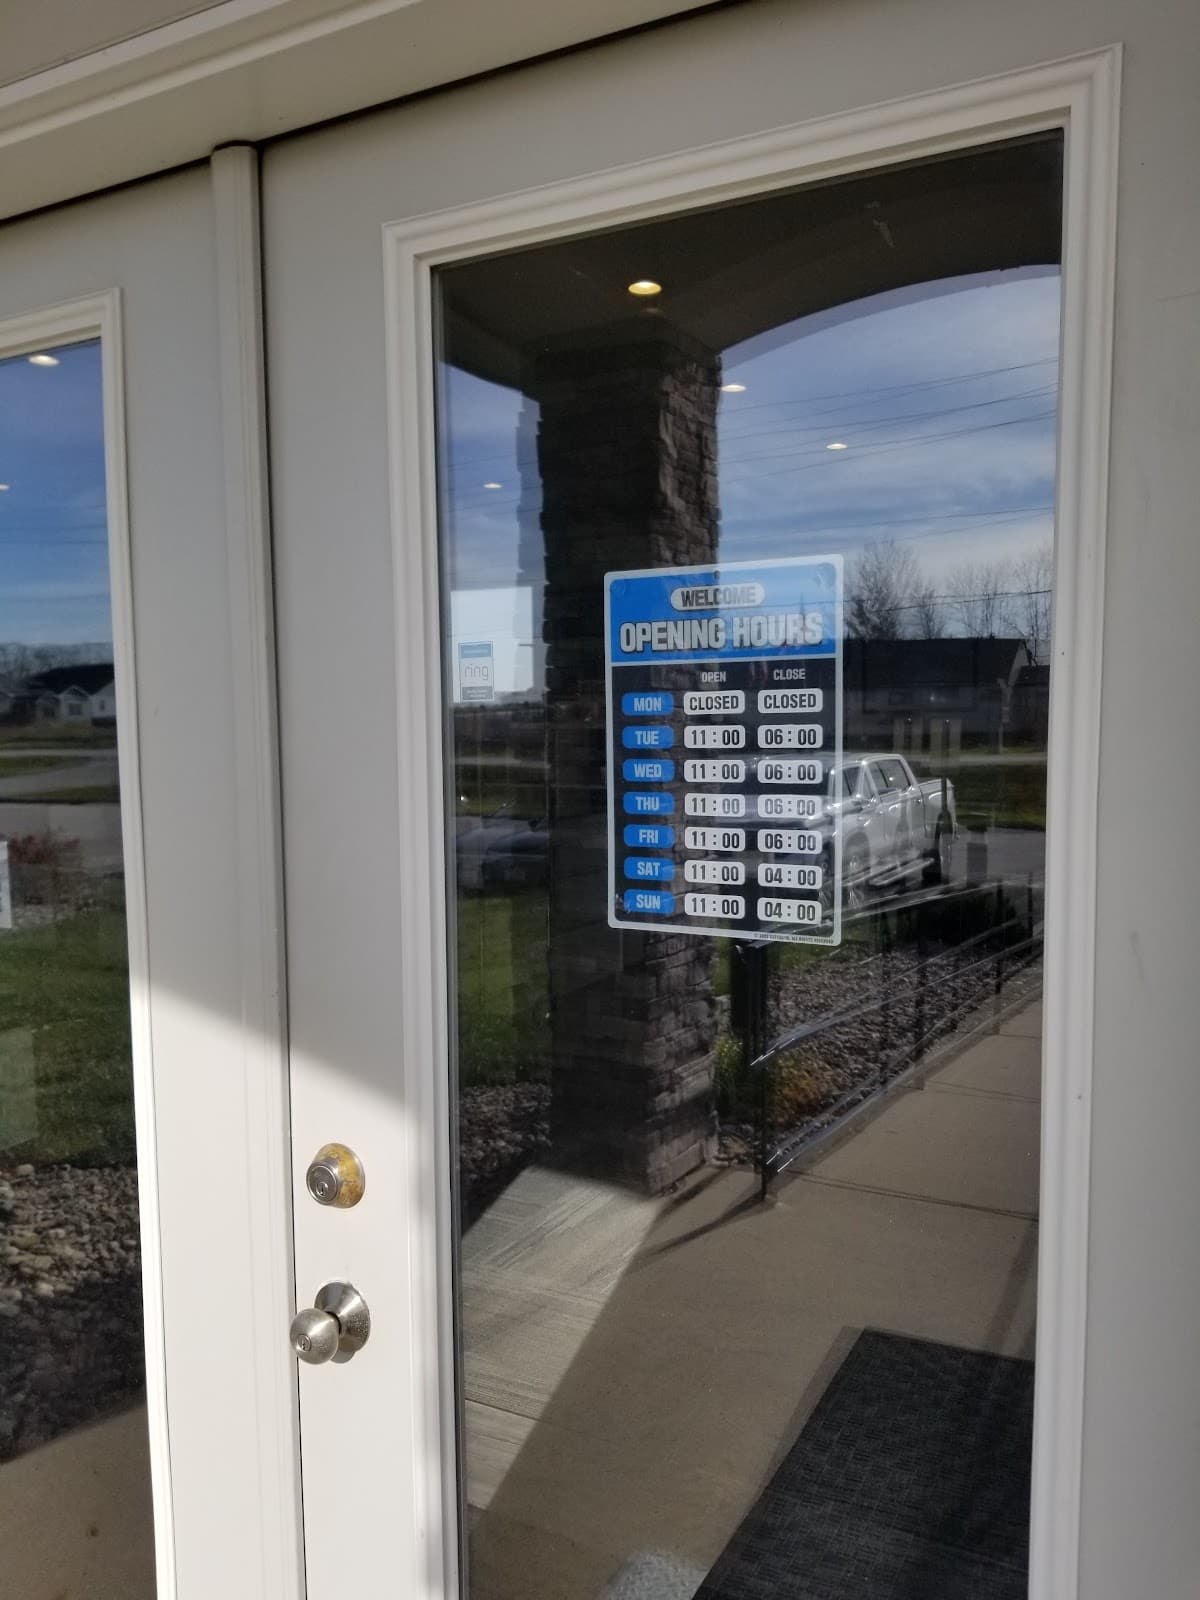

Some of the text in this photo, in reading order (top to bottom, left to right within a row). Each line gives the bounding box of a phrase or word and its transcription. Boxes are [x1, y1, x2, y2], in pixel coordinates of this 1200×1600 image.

[681, 587, 756, 607] WELCOME
[620, 613, 824, 653] OPENING HOURS
[464, 664, 489, 681] ring
[701, 669, 806, 682] OPEN CLOSE
[634, 693, 817, 711] MON CLOSED CLOSED
[635, 731, 659, 745] TUE
[634, 763, 662, 778] WED
[635, 797, 659, 811] THU
[638, 829, 659, 844] FRI
[636, 862, 660, 876] SAT
[636, 895, 661, 910] SUN
